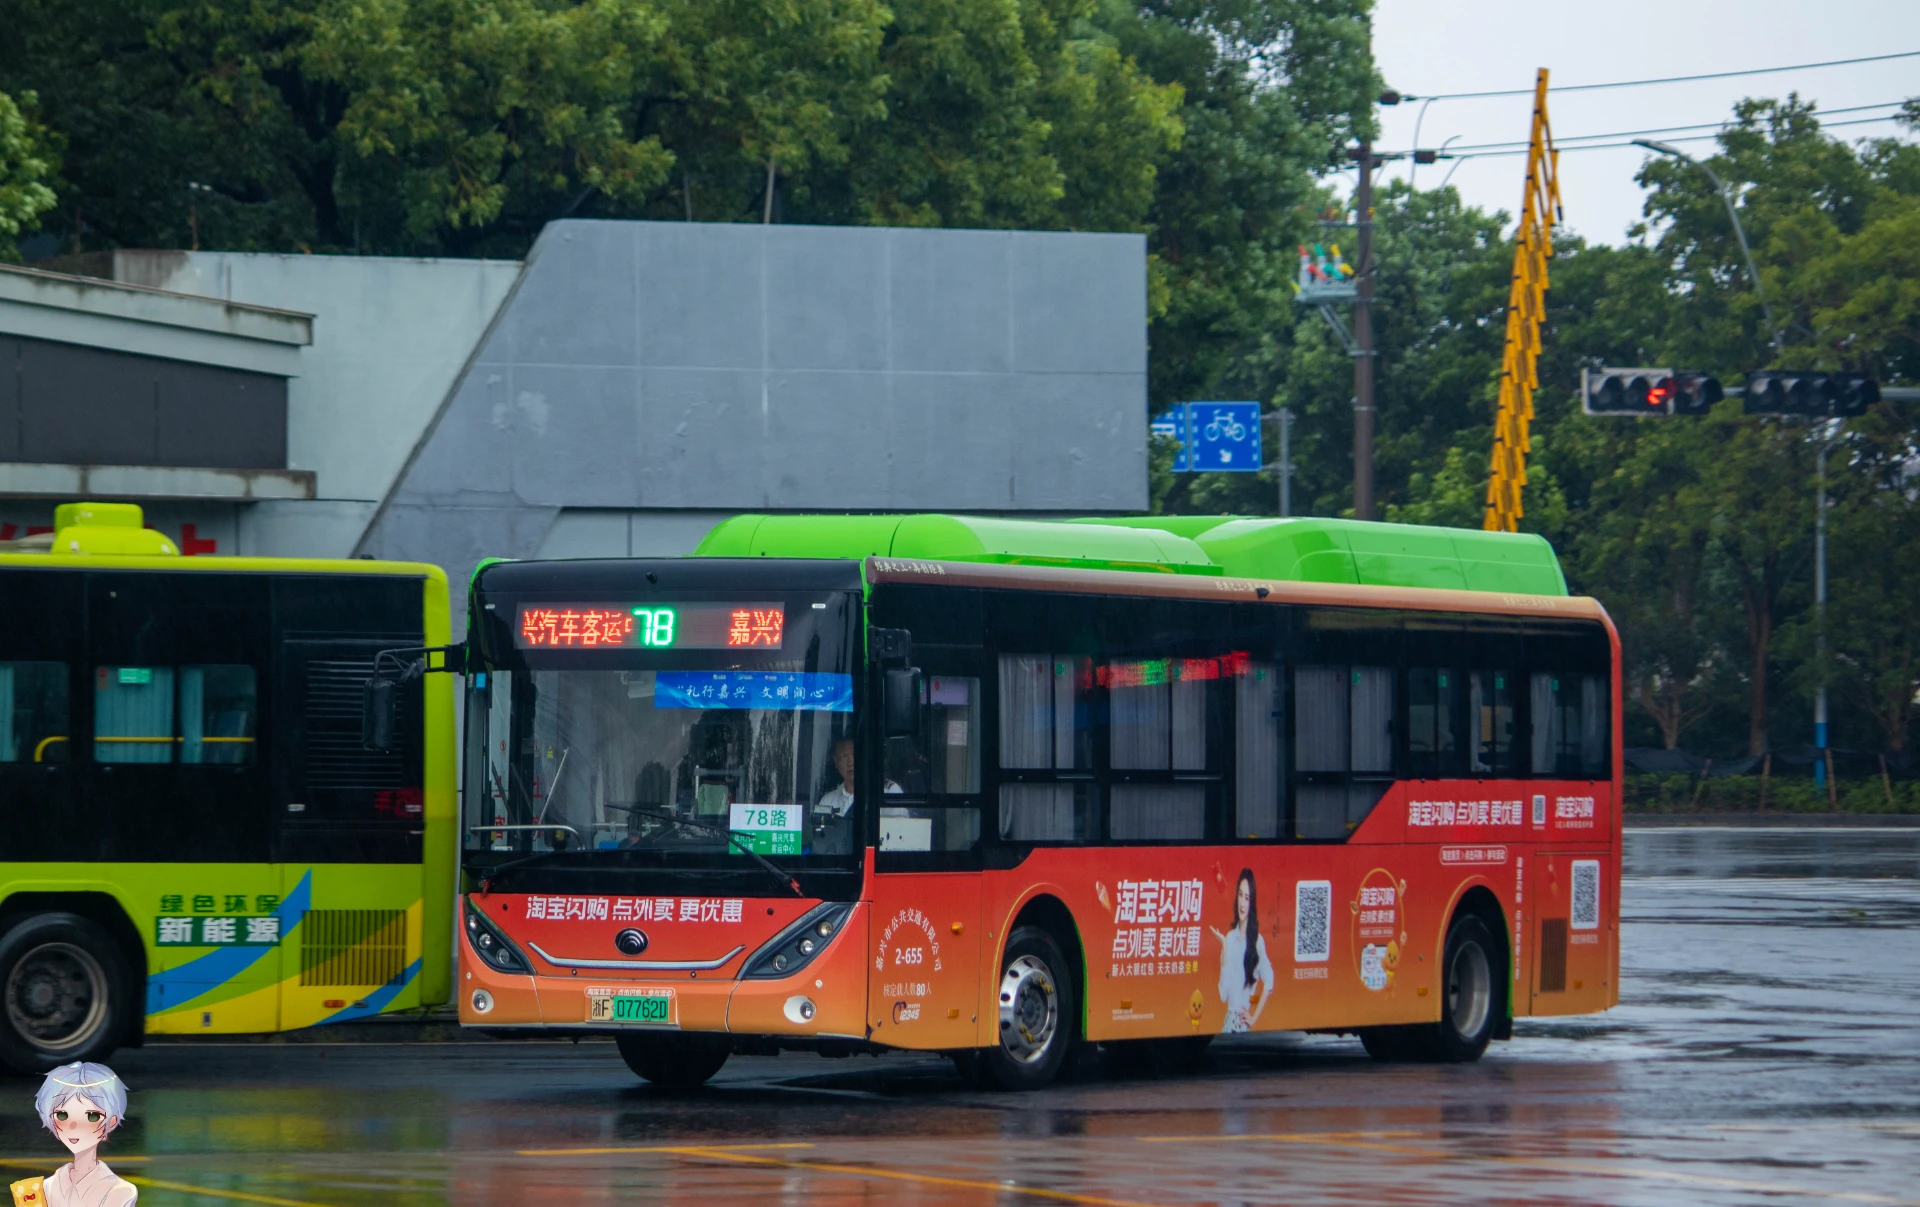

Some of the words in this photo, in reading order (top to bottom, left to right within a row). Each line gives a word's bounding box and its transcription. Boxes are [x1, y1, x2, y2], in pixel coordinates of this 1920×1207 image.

[633, 610, 675, 646] 78
[745, 810, 786, 827] 78路
[160, 895, 280, 913] 绿色环保
[526, 896, 608, 920] 淘宝闪购
[612, 898, 674, 922] 点外卖
[679, 899, 743, 922] 更优惠
[1114, 878, 1203, 924] 淘宝闪购
[159, 917, 280, 942] 新能源
[1112, 928, 1156, 958] 点外卖
[1158, 926, 1201, 957] 更优惠
[895, 947, 922, 965] 2-655
